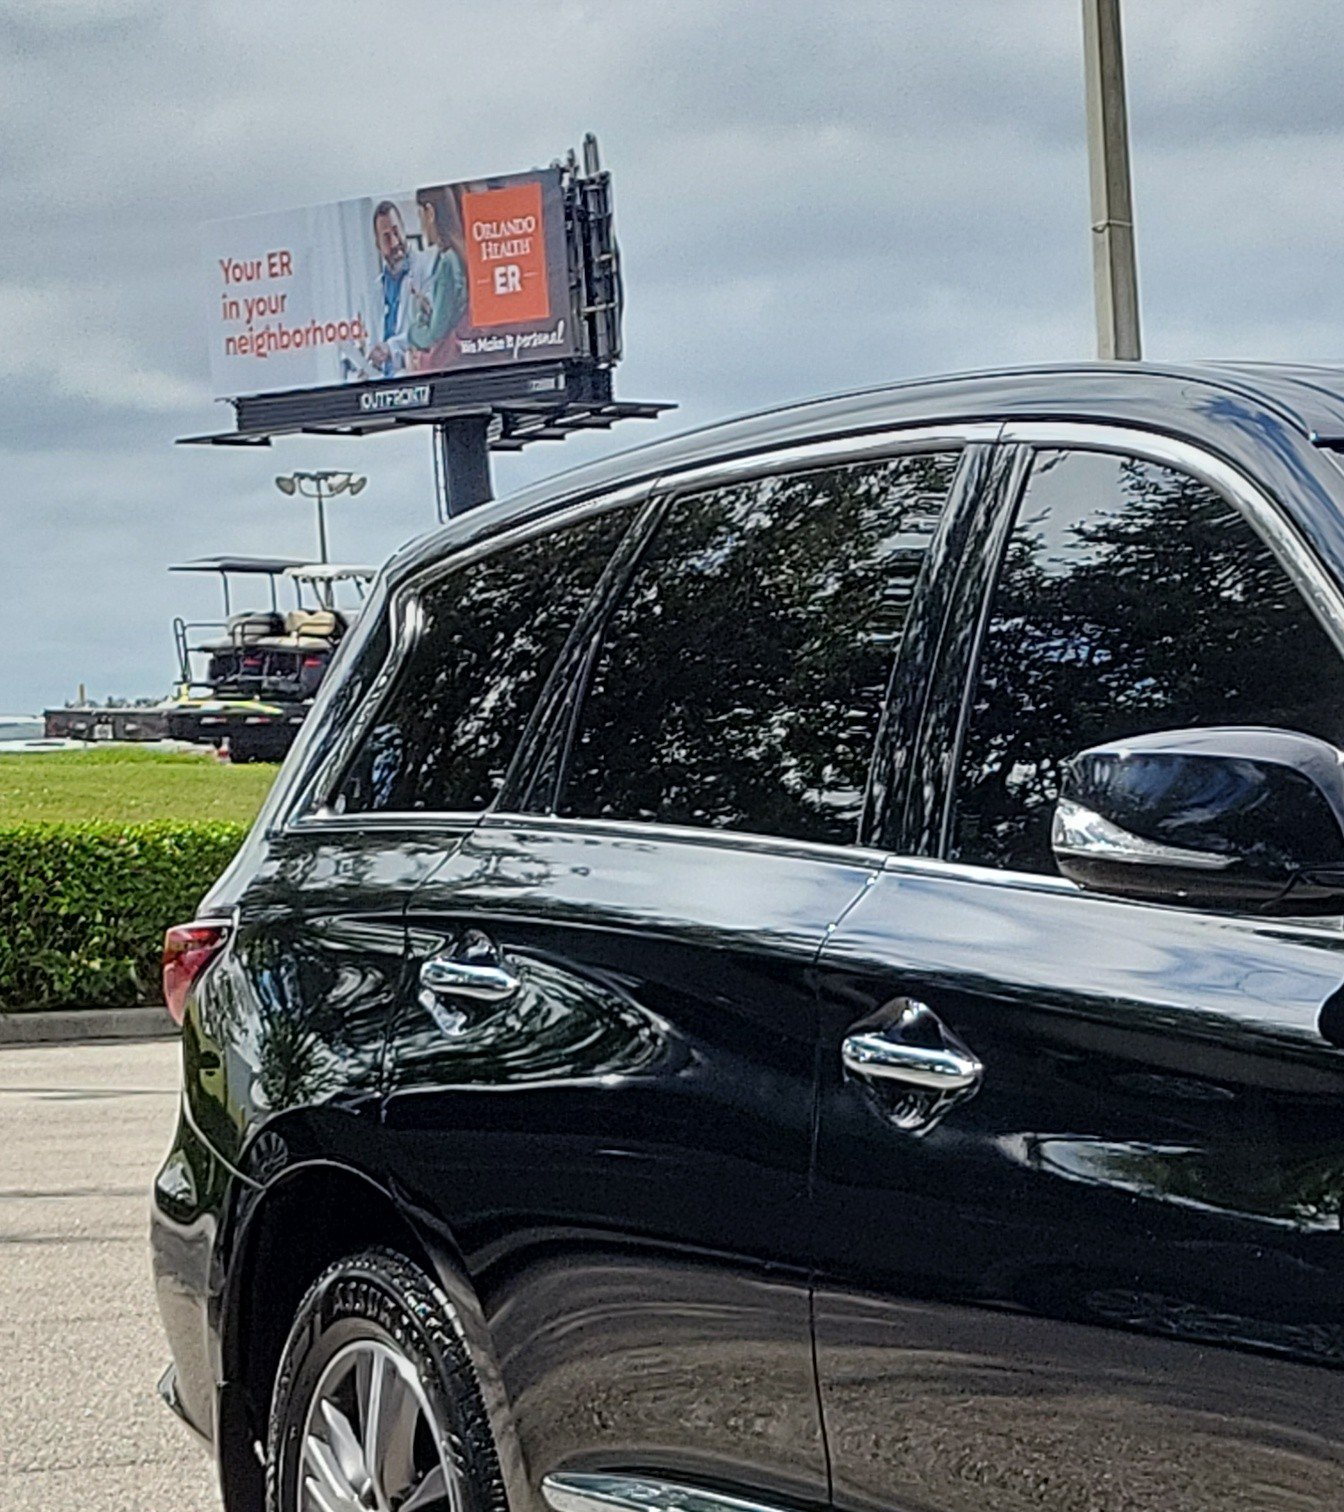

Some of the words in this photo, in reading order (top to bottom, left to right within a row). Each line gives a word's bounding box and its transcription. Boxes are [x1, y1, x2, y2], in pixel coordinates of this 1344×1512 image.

[472, 216, 536, 242] ORLANDO
[481, 237, 532, 261] HEALTH
[219, 257, 262, 284] Your
[267, 250, 293, 278] ER
[494, 264, 522, 295] ER
[221, 293, 240, 320] in
[244, 294, 288, 325] your
